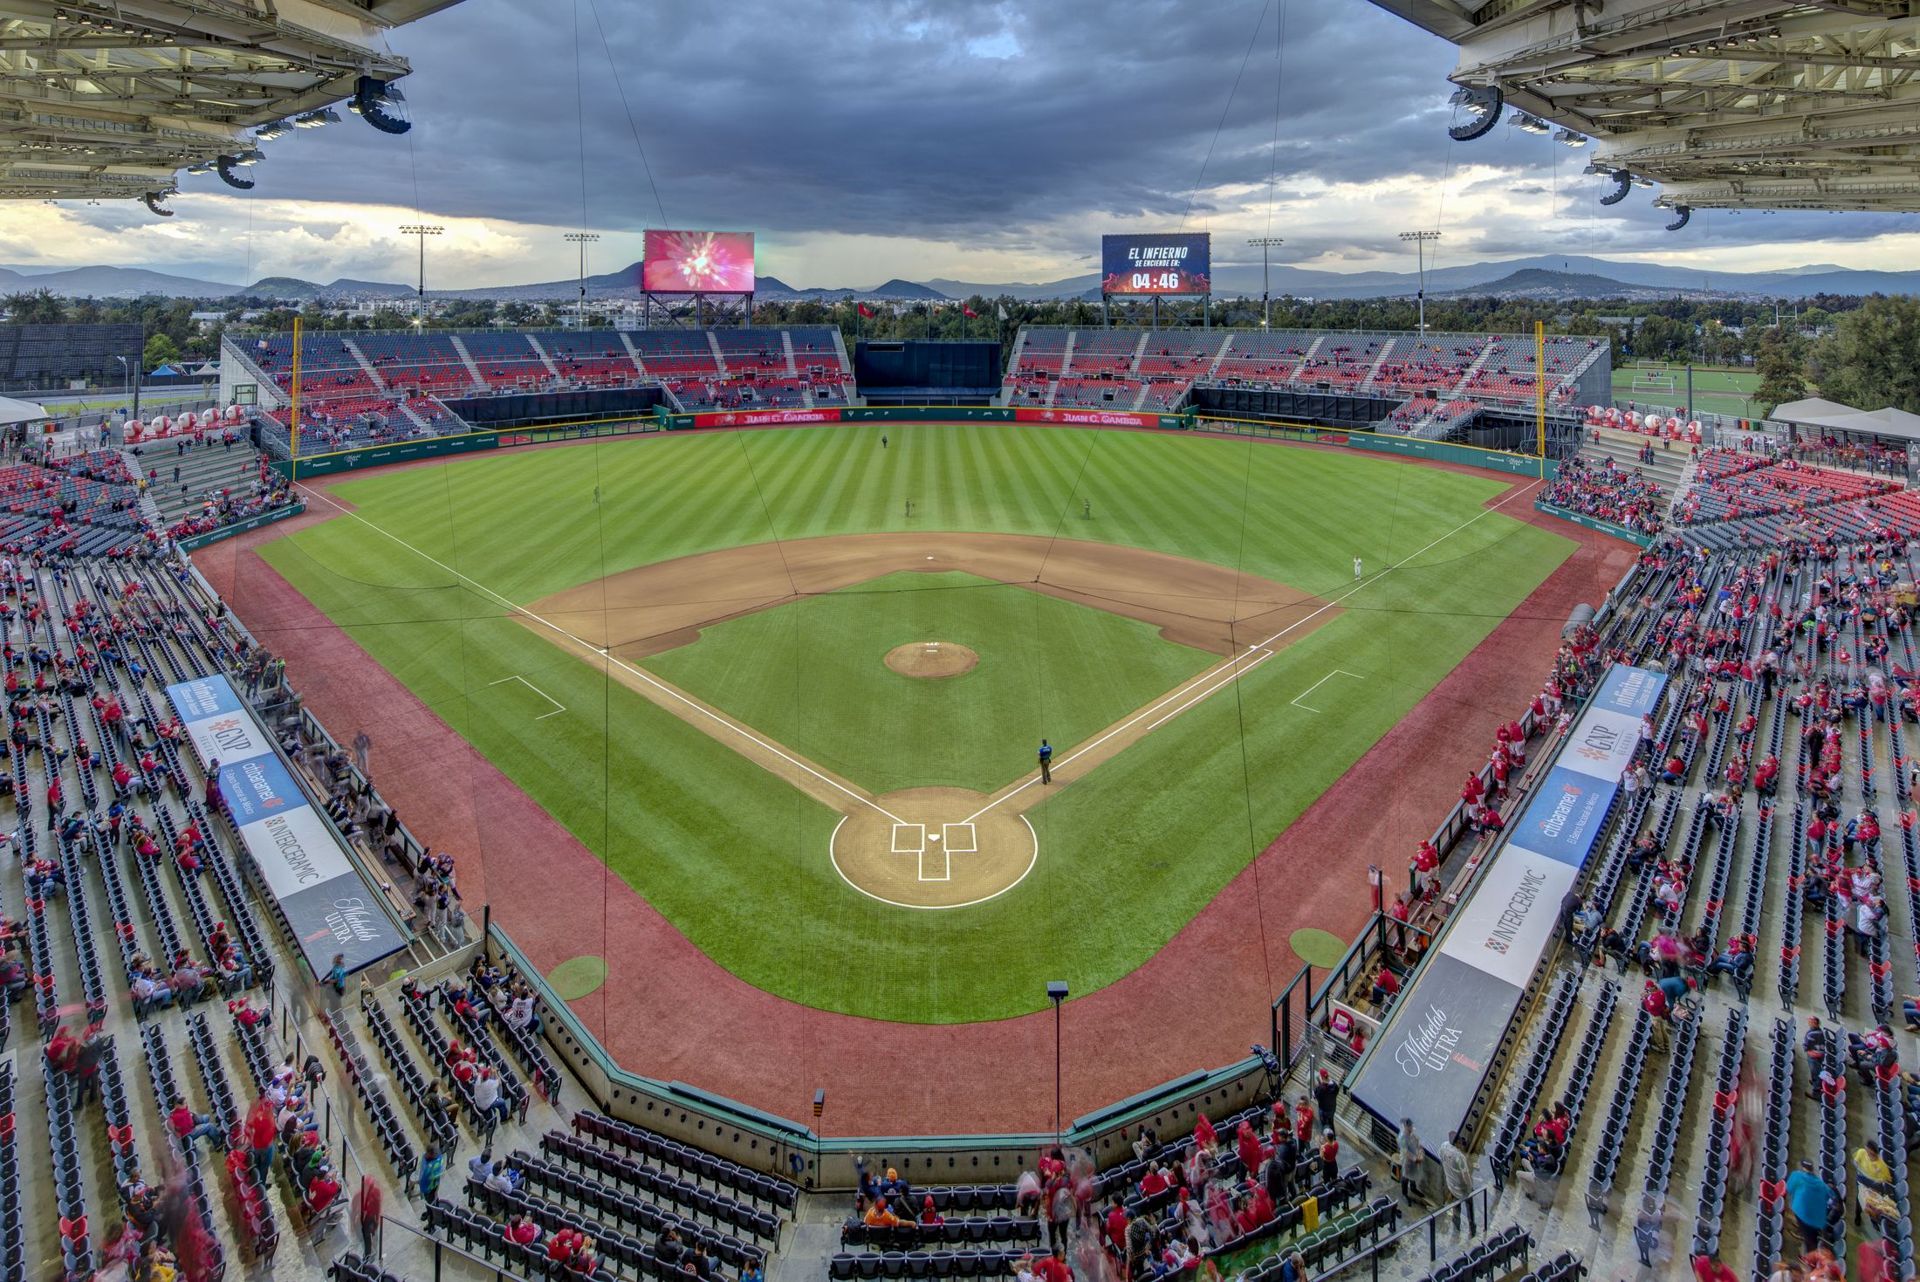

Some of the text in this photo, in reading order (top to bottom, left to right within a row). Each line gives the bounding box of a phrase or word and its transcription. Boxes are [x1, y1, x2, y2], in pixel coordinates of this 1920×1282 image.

[1128, 247, 1188, 259] EL INFIERNO
[1063, 413, 1088, 422] JUAN
[1089, 415, 1100, 423] C.
[1101, 415, 1143, 426] GAMBOA
[1610, 672, 1646, 708] infinitum
[216, 728, 252, 751] GNP
[1585, 725, 1618, 751] GNP
[242, 763, 275, 802] citibanamex
[1542, 792, 1578, 838] citibanamex
[270, 824, 319, 884] INTERCERAMIC
[333, 898, 380, 940] Michelob
[1492, 868, 1546, 942] INTERCERAMIC
[325, 912, 353, 944] ULTRA
[1395, 1004, 1446, 1077] Michelob
[1425, 1028, 1463, 1071] ULTRA
